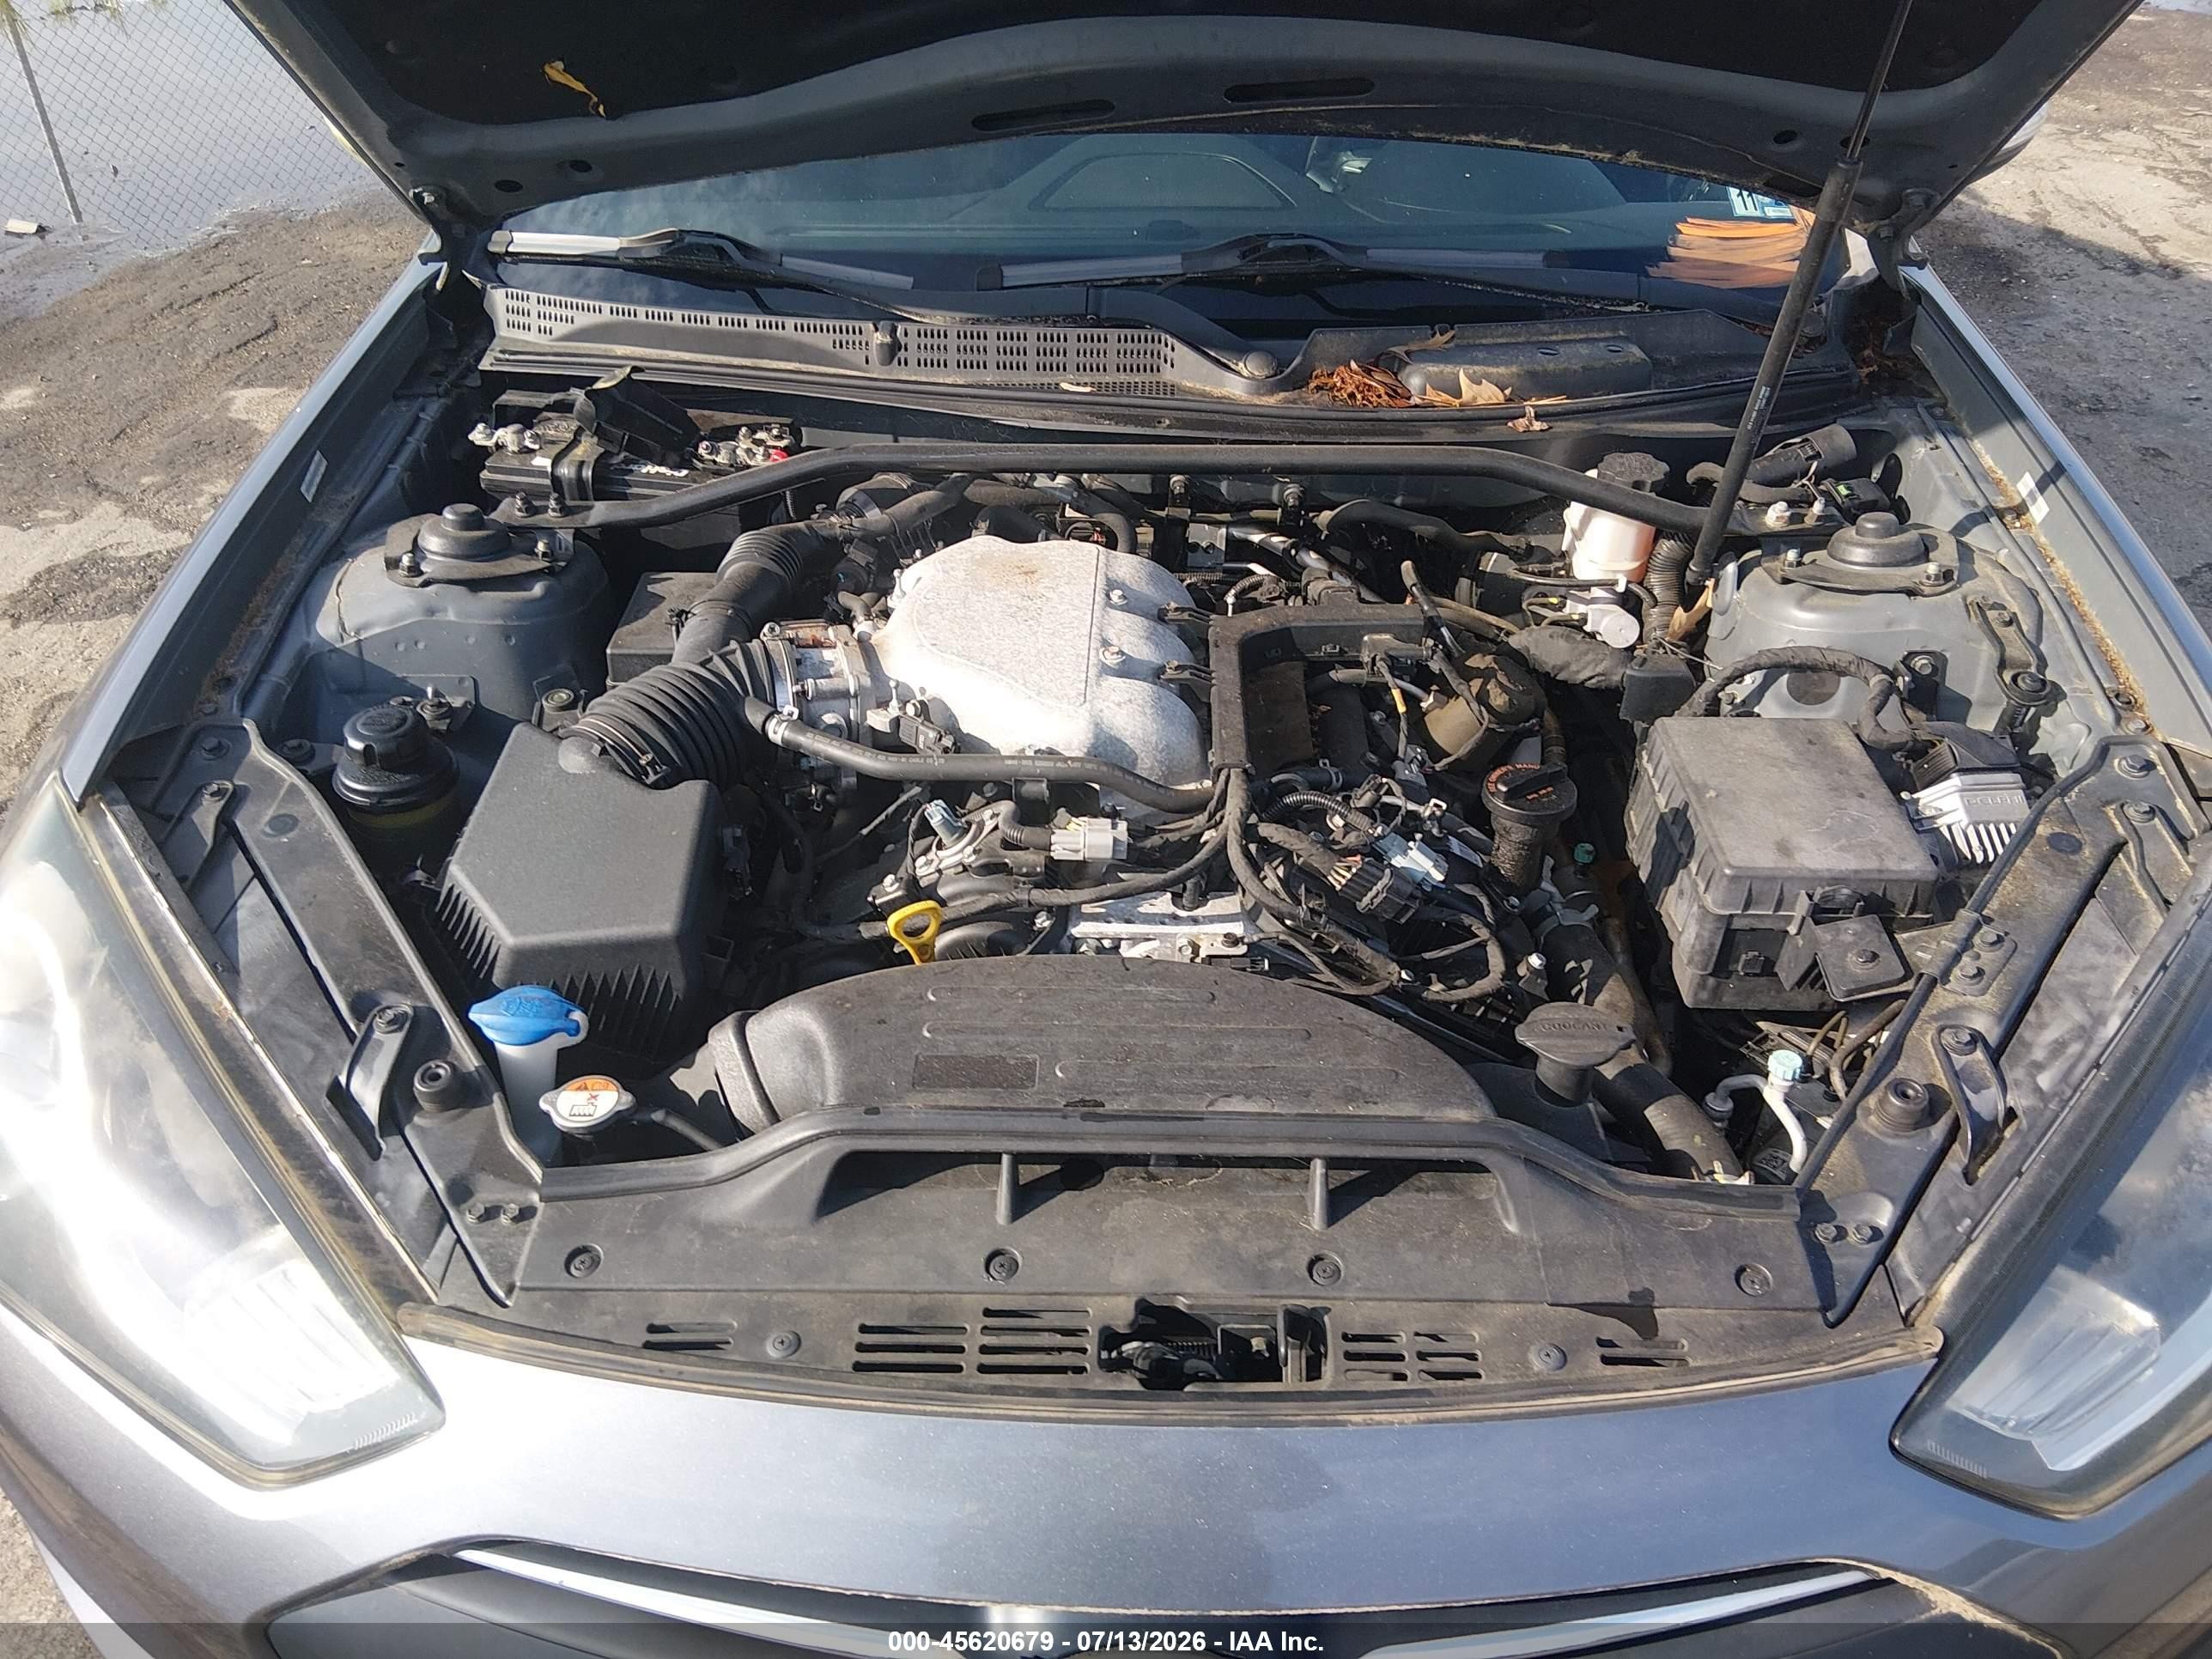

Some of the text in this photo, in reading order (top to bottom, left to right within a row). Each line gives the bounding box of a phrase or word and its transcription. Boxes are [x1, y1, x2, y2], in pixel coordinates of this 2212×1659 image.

[1735, 188, 1759, 212] 11
[1963, 793, 2025, 805] DELPHI
[1540, 1021, 1608, 1032] COOLANT
